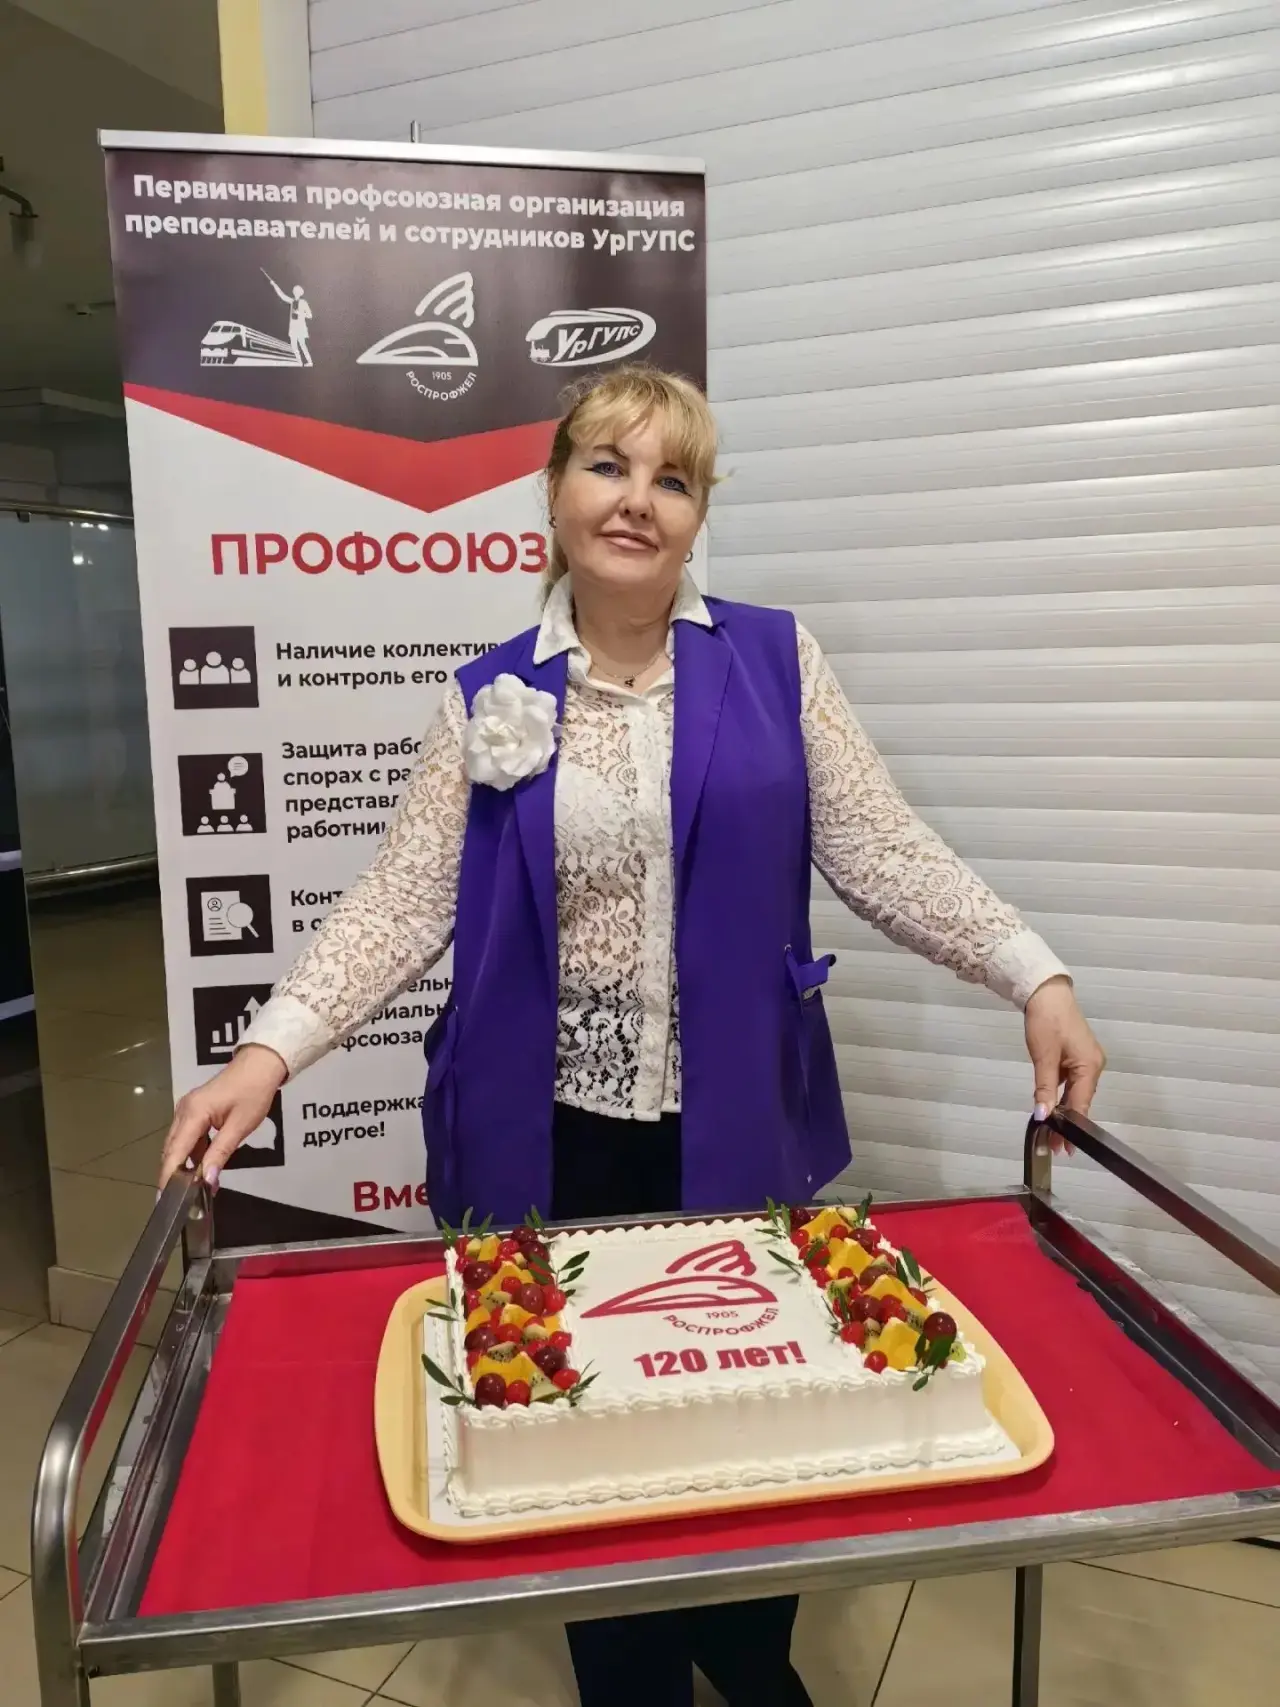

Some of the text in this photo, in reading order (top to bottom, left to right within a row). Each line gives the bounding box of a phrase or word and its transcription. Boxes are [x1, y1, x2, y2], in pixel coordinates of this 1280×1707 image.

[133, 174, 685, 220] Первичная профсоюзная организация
[125, 214, 696, 257] преподавателей и сотрудников УрГУПС
[551, 323, 642, 363] УрГУПС
[405, 370, 478, 402] РОСПРОФЖЕЛ
[432, 371, 453, 381] 1905
[211, 531, 548, 575] ПРОФСОЮЗ
[276, 642, 376, 661] Наличие
[277, 669, 448, 689] и контроль его
[281, 741, 367, 760] Защита
[283, 769, 363, 788] спорах
[369, 768, 381, 782] с
[292, 919, 304, 932] в
[303, 1120, 385, 1148] другое!
[662, 1307, 780, 1337] РОСПРОФЖЕЛ
[705, 1310, 740, 1320] 1905
[633, 1340, 807, 1379] 120 лет!
